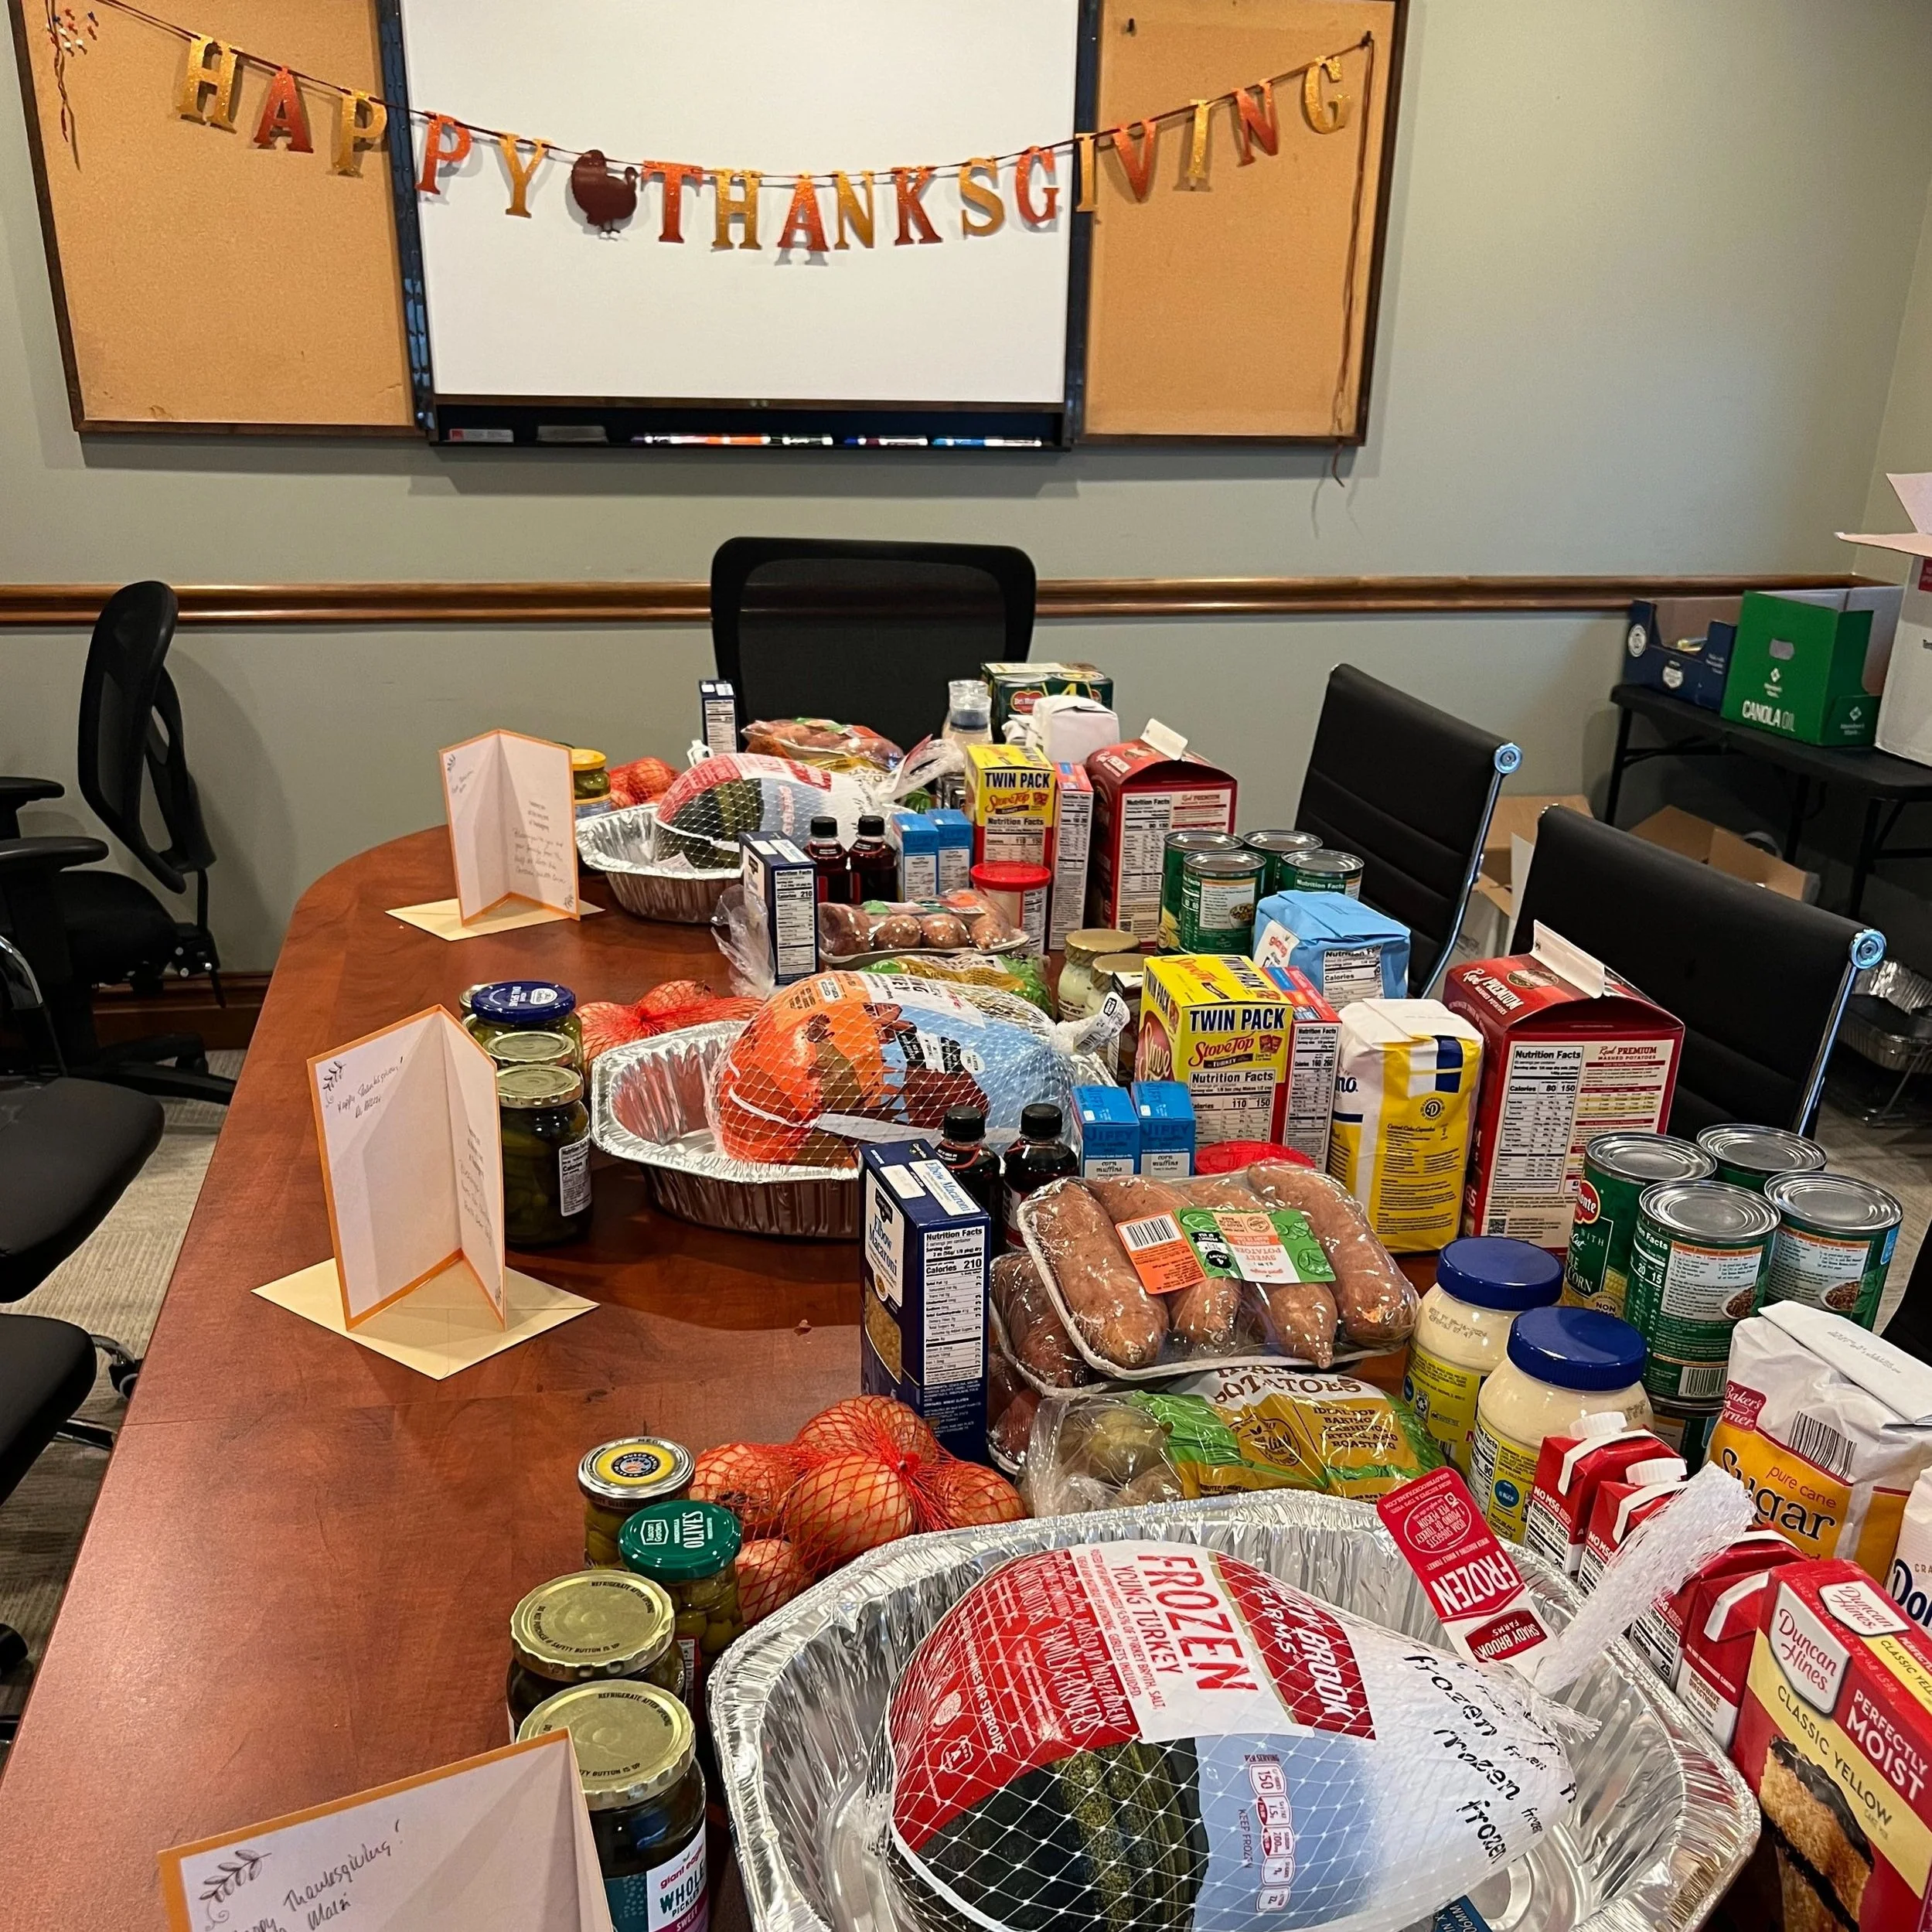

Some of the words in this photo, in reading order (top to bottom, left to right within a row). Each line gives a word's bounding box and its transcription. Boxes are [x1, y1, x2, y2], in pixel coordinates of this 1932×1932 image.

[177, 34, 552, 218] HAPPY
[642, 56, 1353, 252] THANKSGIVING
[1742, 700, 1780, 727] CANOLA
[1782, 710, 1795, 731] OIL
[985, 773, 1016, 789] TWIN
[1021, 773, 1049, 789] PACK
[1297, 879, 1325, 888] Nutrition
[1145, 966, 1158, 1000] TWIN
[1156, 980, 1170, 1014] PACK
[1484, 978, 1524, 1010] PREMIUM
[1190, 1010, 1236, 1033] TWIN
[1241, 1008, 1286, 1031] PACK
[1515, 1051, 1554, 1059] Nutrition
[1556, 1051, 1581, 1059] Facts
[1192, 1073, 1240, 1083] Nutrition
[1245, 1072, 1273, 1082] Facts
[1232, 1100, 1246, 1109] 110
[1256, 1099, 1270, 1107] 150
[1085, 1126, 1133, 1141] JIFFY
[1141, 1123, 1190, 1136] JIFFY
[874, 1214, 893, 1252] Elbow
[926, 1232, 960, 1241] Nutrition
[963, 1228, 983, 1236] Facts
[1645, 1232, 1668, 1250] Facts
[869, 1223, 898, 1276] Macaroni
[926, 1266, 957, 1274] Calories
[963, 1259, 982, 1269] 210
[1637, 1263, 1646, 1275] 20
[1651, 1270, 1662, 1283] 15
[1567, 1266, 1593, 1293] CORN
[1596, 1301, 1617, 1312] NON
[1725, 1385, 1763, 1410] Baker's
[1722, 1409, 1753, 1426] orner
[1483, 1433, 1498, 1449] Facts
[1484, 1464, 1492, 1477] 90
[1534, 1486, 1545, 1500] NO
[1545, 1497, 1560, 1512] MSG
[1766, 1466, 1797, 1490] pure
[1800, 1485, 1837, 1508] cane
[1415, 1508, 1440, 1529] PERSON
[1436, 1501, 1450, 1515] PER
[1440, 1508, 1462, 1527] POUND
[1532, 1501, 1555, 1525] Nutrition
[1555, 1523, 1569, 1540] Facts
[683, 1511, 704, 1549] OLIVES
[1412, 1524, 1437, 1545] TURKEY
[1433, 1518, 1444, 1532] OF
[1450, 1517, 1467, 1532] USDA
[1424, 1526, 1454, 1549] SUGGESTS
[1588, 1531, 1600, 1548] NO
[591, 1581, 631, 1590] REFRIGERATE
[630, 1587, 645, 1598] AFTER
[1430, 1550, 1520, 1617] FROZEN
[1251, 1585, 1297, 1654] FARMS
[1830, 1594, 1874, 1630] Hines
[1838, 1586, 1894, 1628] Duncan
[1069, 1613, 1101, 1652] RAISED
[1112, 1566, 1152, 1605] YOUNG
[1132, 1609, 1184, 1675] TURKEY
[1137, 1555, 1259, 1691] FROZEN
[1492, 1617, 1525, 1635] FARMS
[1517, 1618, 1542, 1641] SHADY
[550, 1641, 573, 1652] SAFETY
[1473, 1629, 1515, 1660] BROOK
[1663, 1624, 1678, 1644] Facts
[1779, 1608, 1837, 1677] Duncan
[1038, 1625, 1082, 1671] FAMILY
[1083, 1647, 1105, 1665] BY
[1881, 1640, 1917, 1674] CLASSIC
[1106, 1631, 1128, 1662] GIBLETS
[1117, 1661, 1143, 1699] INCLUDED.
[1294, 1626, 1357, 1720] BROOK
[1661, 1661, 1671, 1677] 25
[1780, 1643, 1826, 1691] Hines
[598, 1692, 642, 1701] REFRIGERATE
[642, 1698, 659, 1709] AFTER
[973, 1683, 988, 1700] OR
[1052, 1666, 1105, 1735] FARMERS
[1087, 1661, 1132, 1727] INDEPENDENT
[1149, 1690, 1166, 1710] SALT,
[1402, 1655, 1498, 1736] frozen
[1690, 1671, 1721, 1705] MICROWAVE
[1854, 1688, 1928, 1775] PERFECTLY
[1433, 1729, 1521, 1801] frozen
[1777, 1685, 1830, 1756] CLASSIC
[1834, 1751, 1892, 1825] YELLOW
[1846, 1705, 1925, 1801] MOIST
[1258, 1770, 1274, 1789] 150
[1237, 1808, 1250, 1831] KEEP
[1456, 1800, 1507, 1864] frozen
[659, 1859, 704, 1914] WHOLE
[660, 1866, 684, 1889] giant
